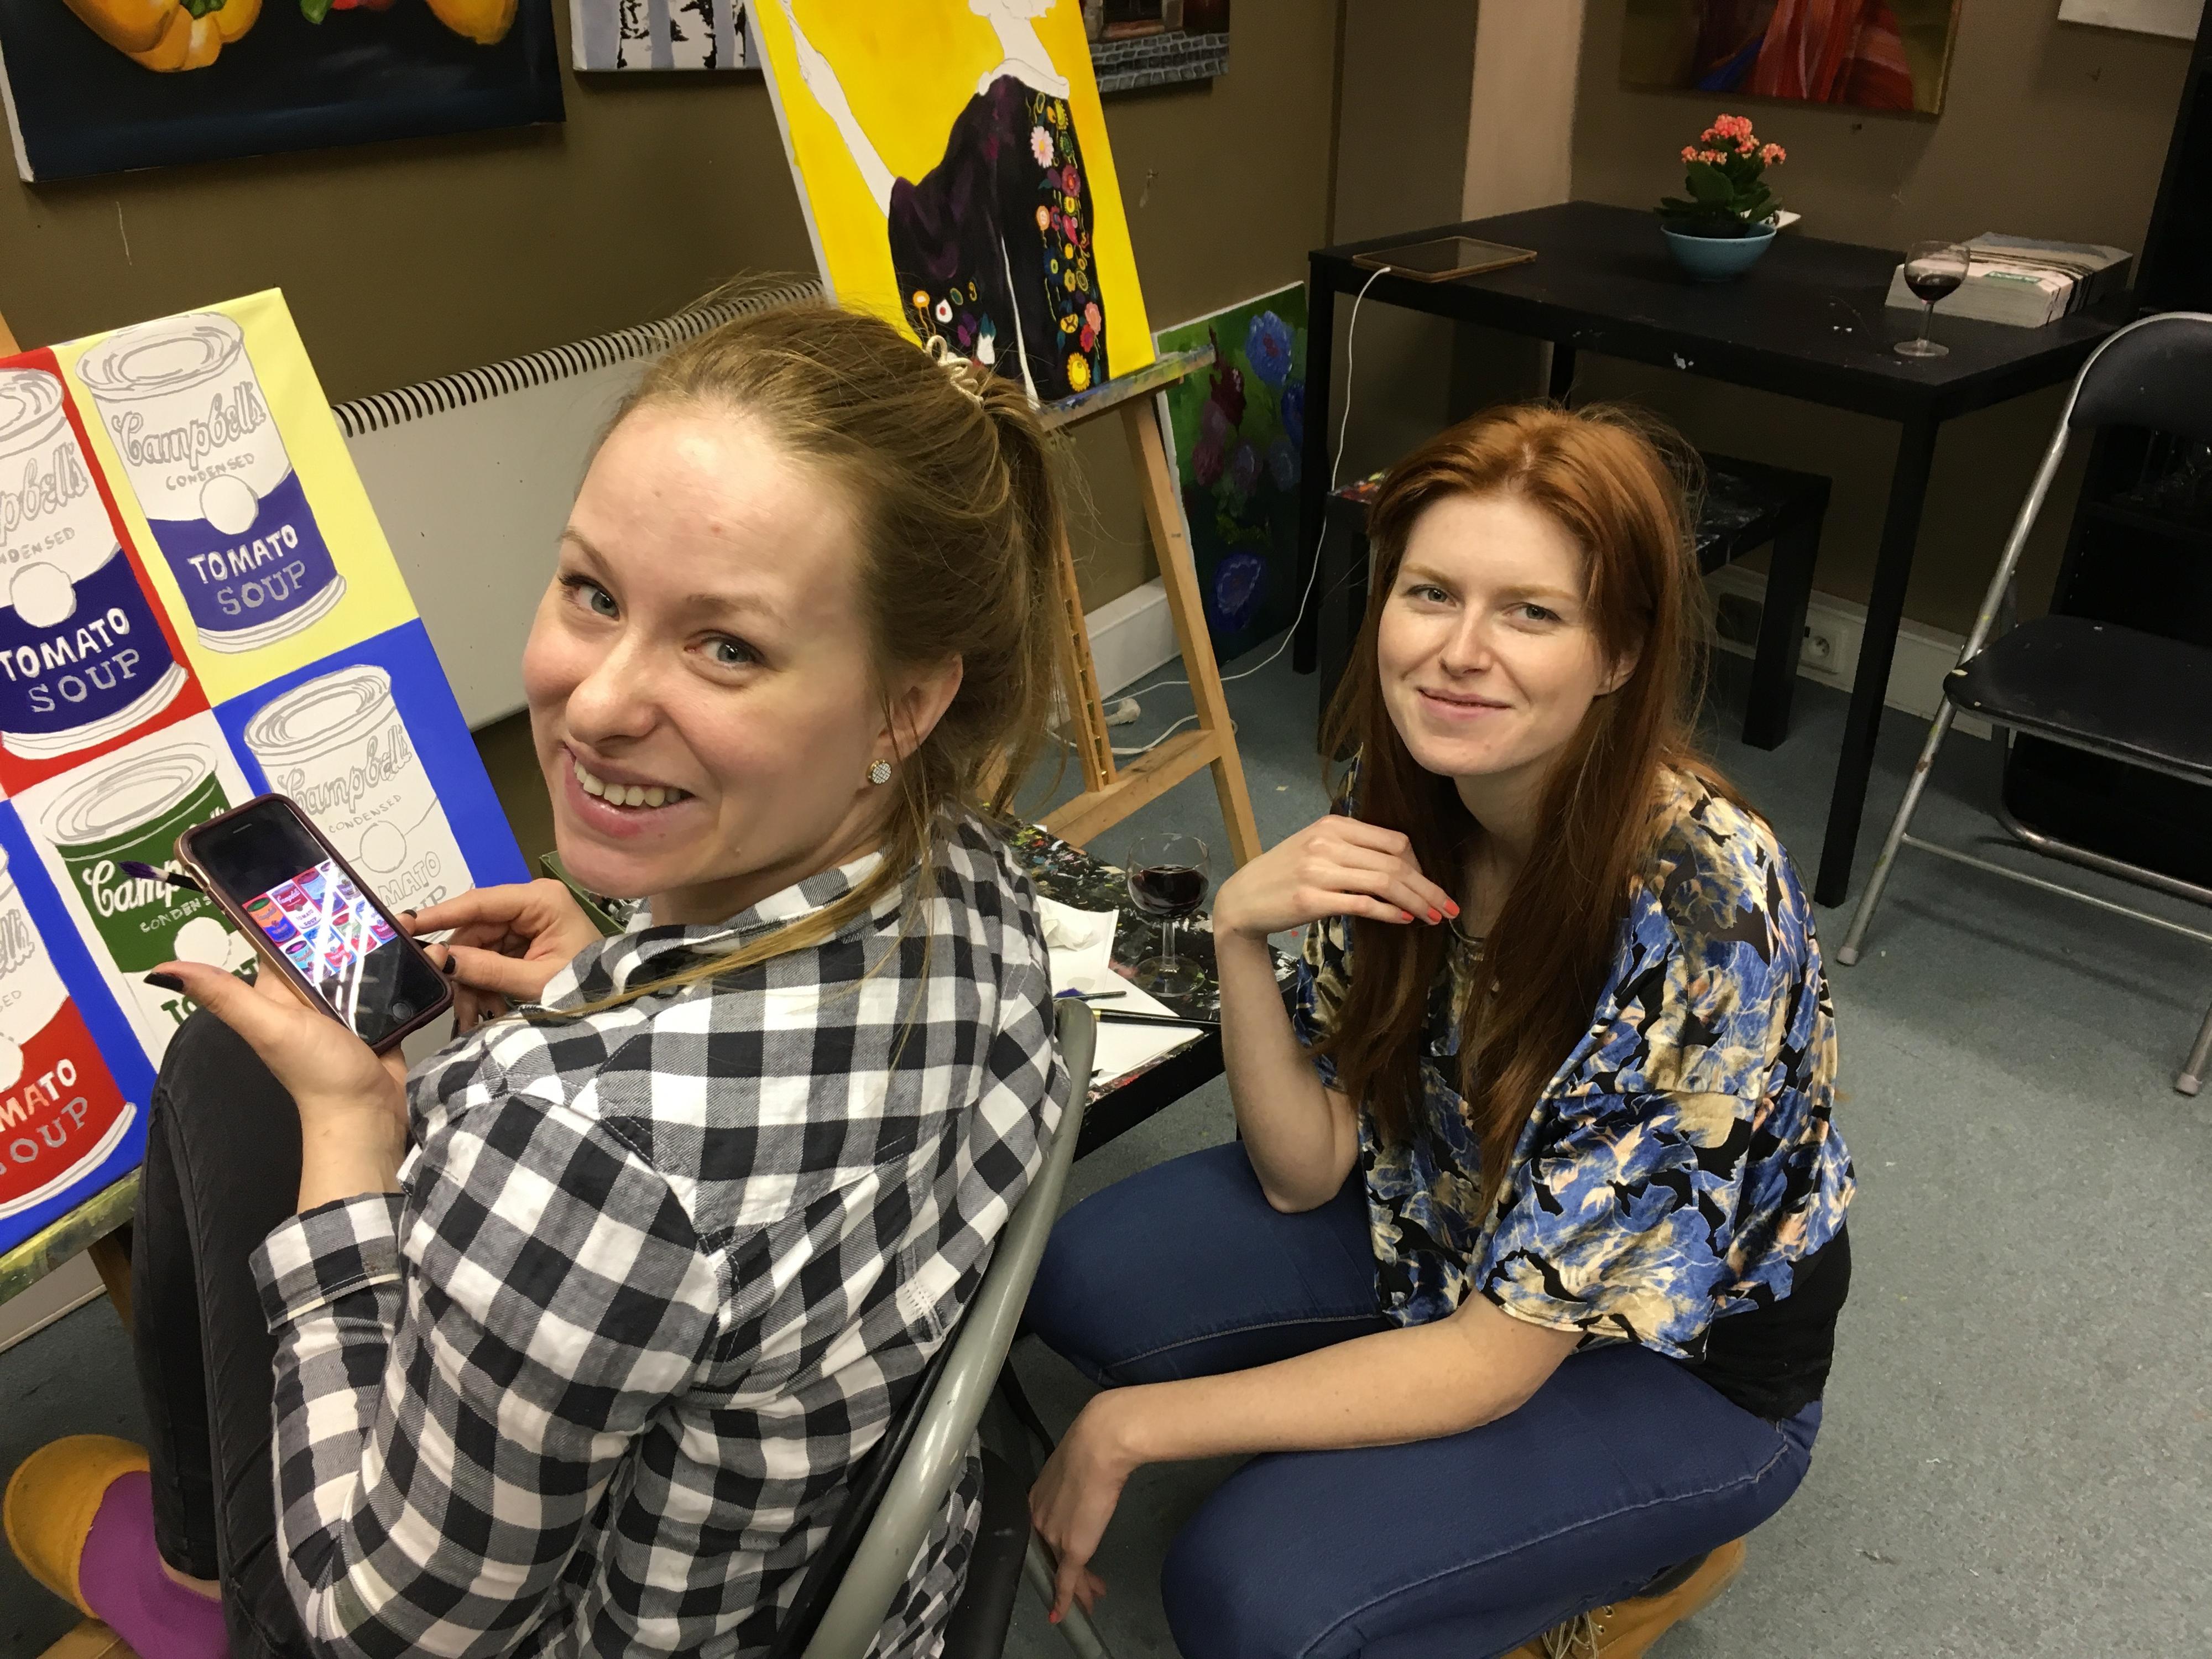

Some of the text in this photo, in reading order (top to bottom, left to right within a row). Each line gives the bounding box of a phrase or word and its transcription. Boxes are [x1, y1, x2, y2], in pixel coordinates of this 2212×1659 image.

[166, 452, 254, 491] CONDENSED
[187, 524, 299, 584] TOMATO
[217, 560, 306, 614] SOUP
[0, 608, 131, 682] TOMATO
[28, 649, 140, 713] SOUP
[328, 795, 401, 833] CONDENSED
[378, 851, 441, 907] MATO
[139, 895, 213, 933] CONDENS
[0, 1058, 77, 1133] MATO
[0, 1097, 88, 1175] OUP
